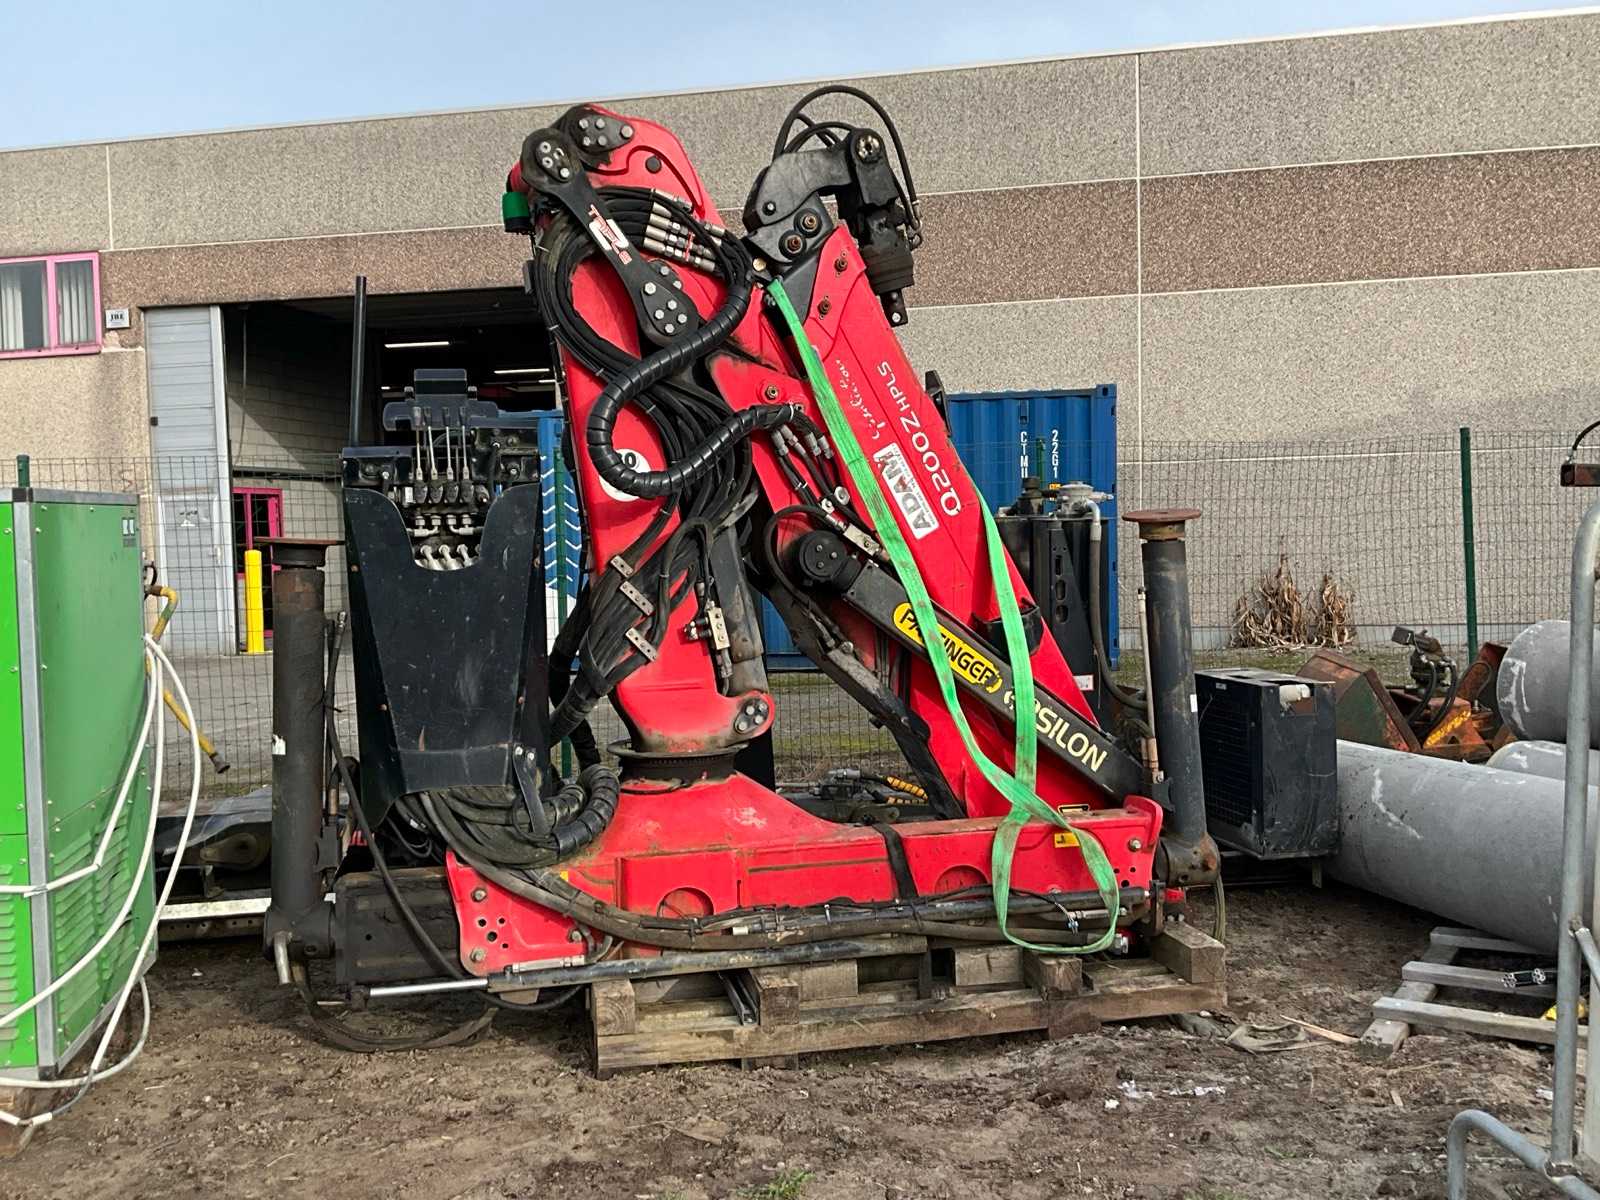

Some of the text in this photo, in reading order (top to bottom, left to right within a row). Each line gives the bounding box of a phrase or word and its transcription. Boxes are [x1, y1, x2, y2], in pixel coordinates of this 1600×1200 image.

[877, 361, 910, 412] HPLS
[900, 410, 961, 516] Q200Z
[1051, 429, 1059, 479] 22G1
